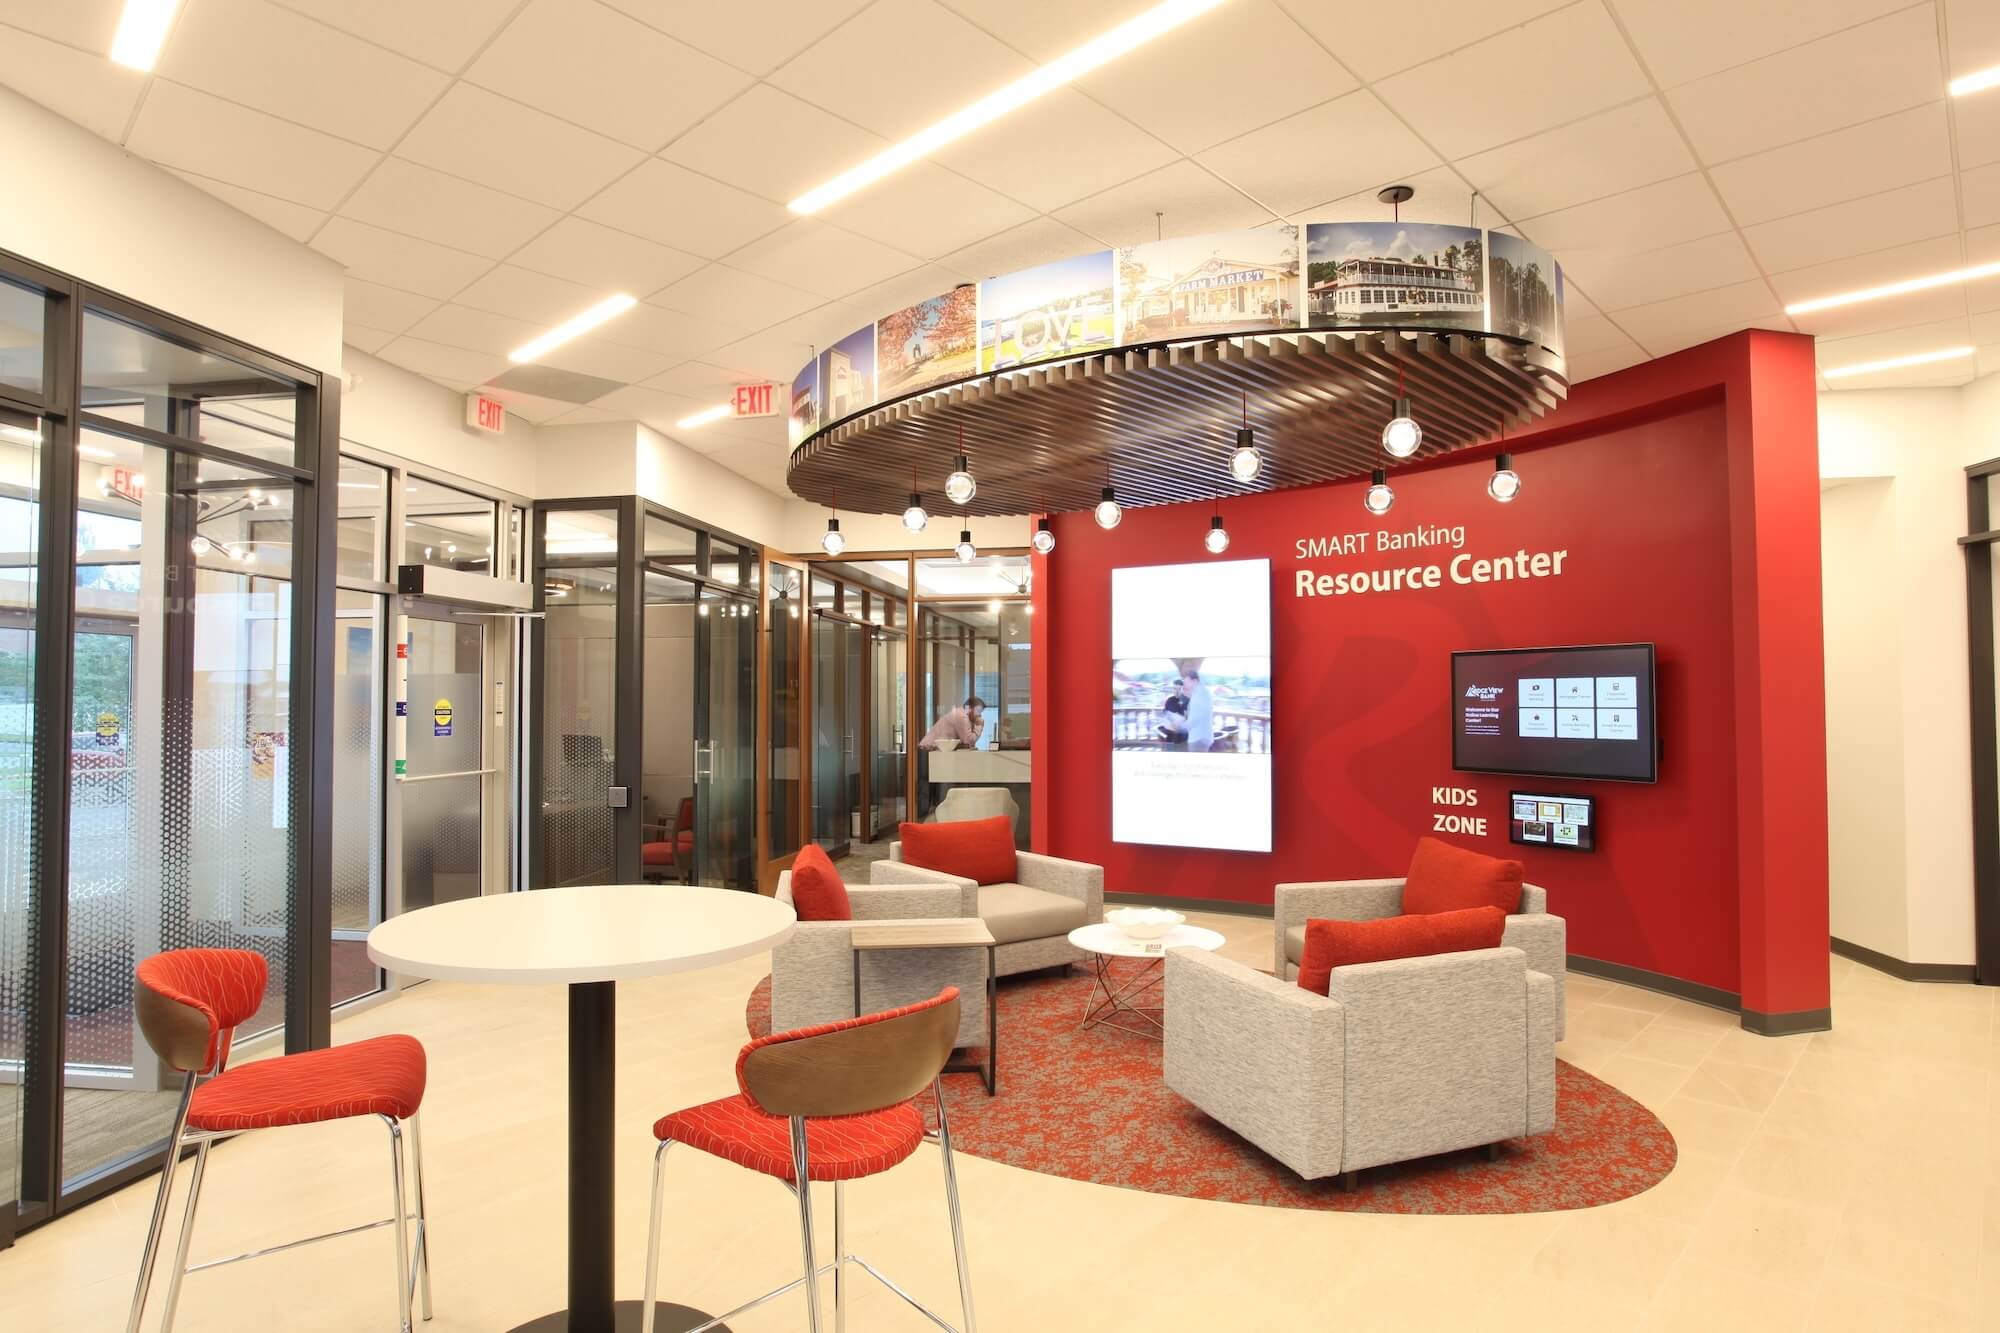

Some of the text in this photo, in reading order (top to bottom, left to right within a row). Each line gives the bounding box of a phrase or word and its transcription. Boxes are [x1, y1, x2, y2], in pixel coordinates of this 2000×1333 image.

[1178, 270, 1264, 292] FARM MARKET
[993, 295, 1110, 367] LOVE
[479, 398, 502, 432] EXIT
[736, 384, 773, 415] EXIT
[1295, 525, 1465, 559] SMART Banking
[1295, 549, 1567, 597] Resource Center
[1432, 786, 1478, 807] KIDS
[1432, 813, 1487, 836] ZONE
